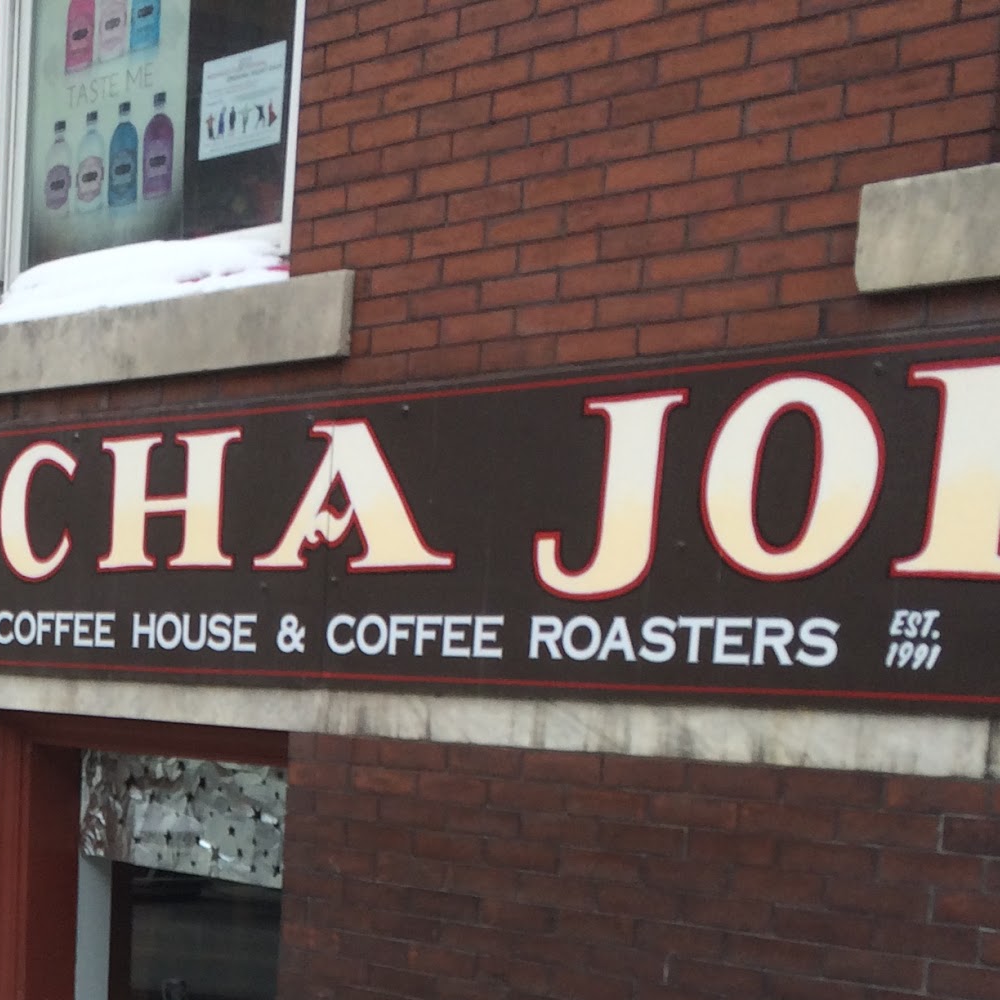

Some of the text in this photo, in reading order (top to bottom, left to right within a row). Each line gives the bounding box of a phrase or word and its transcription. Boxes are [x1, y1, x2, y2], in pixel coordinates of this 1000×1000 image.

[66, 62, 153, 109] TASTE ME
[132, 612, 257, 653] HOUSE
[276, 614, 306, 653] &
[326, 614, 504, 659] COFFEE
[529, 615, 840, 668] ROASTERS
[889, 609, 941, 640] EST.
[884, 641, 942, 671] 1991
